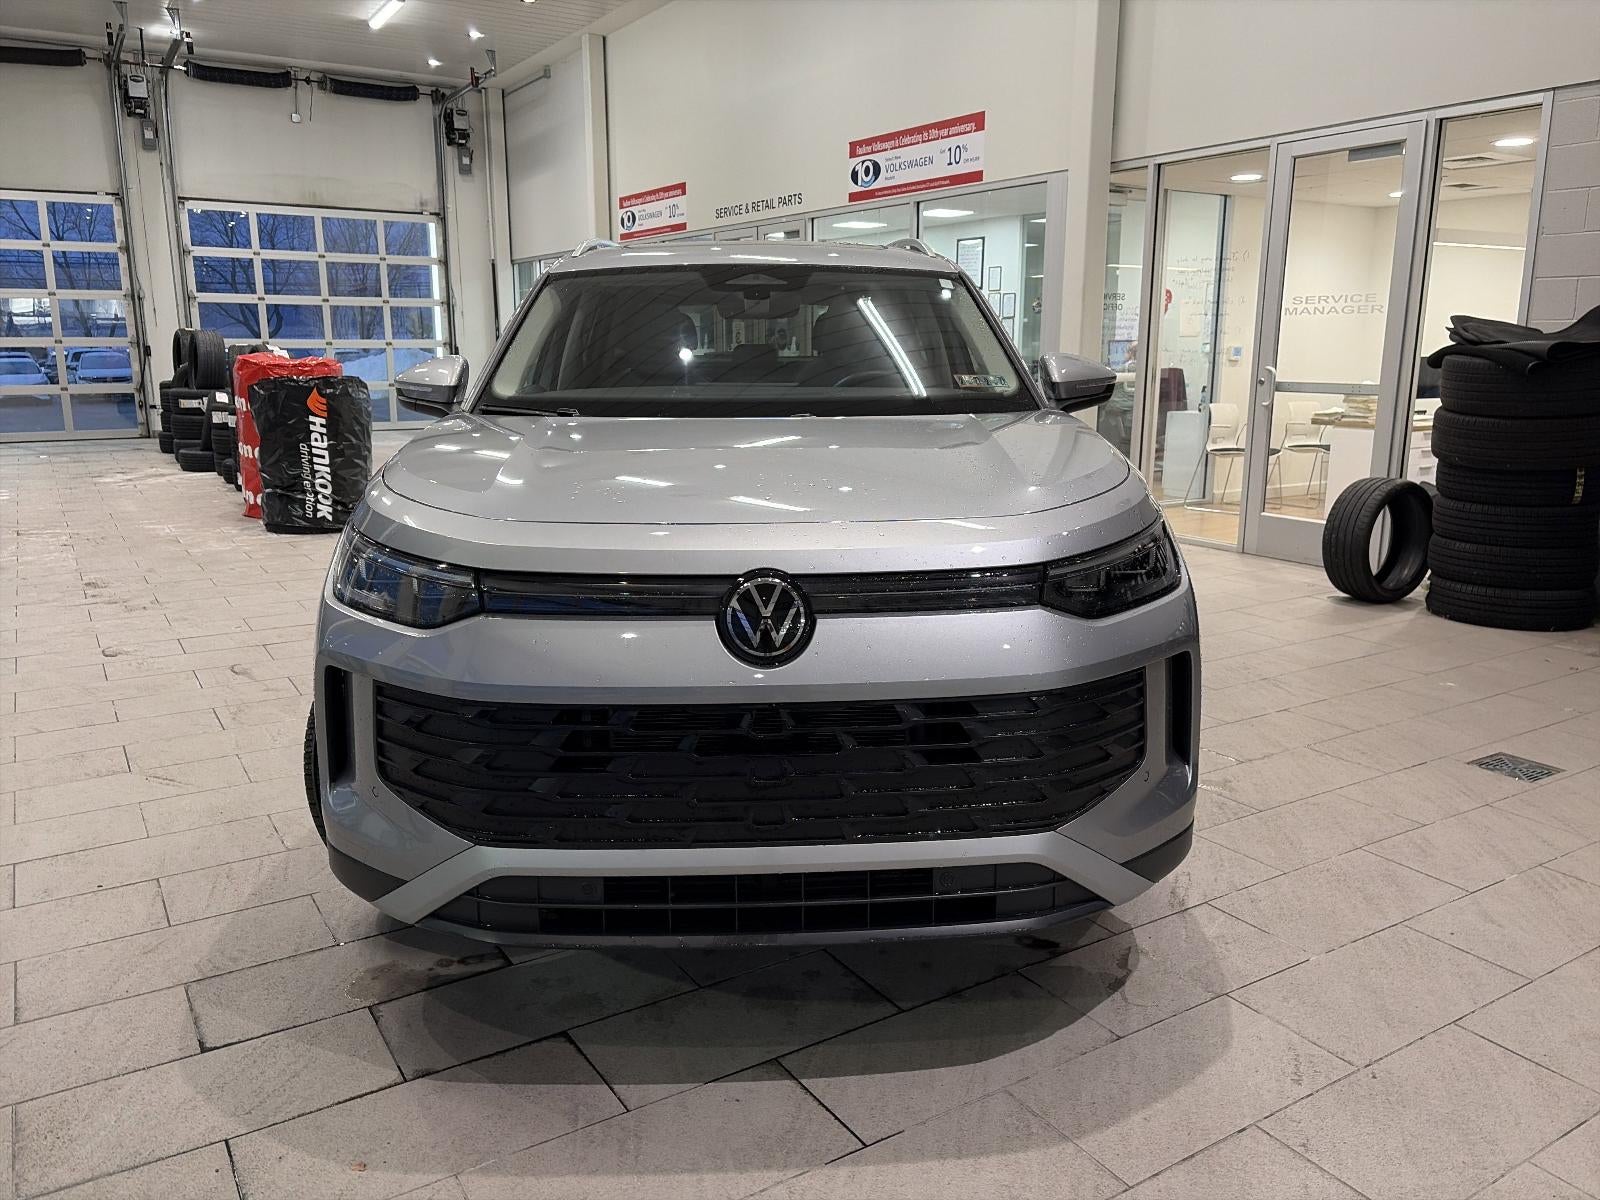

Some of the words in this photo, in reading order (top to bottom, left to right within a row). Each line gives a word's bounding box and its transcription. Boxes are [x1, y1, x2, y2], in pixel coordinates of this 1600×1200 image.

[899, 131, 922, 146] Celebrating
[885, 155, 934, 174] VOLKSWAGEN
[715, 204, 743, 219] SERVICE
[745, 203, 750, 214] &
[752, 198, 776, 213] RETAIL
[778, 192, 803, 208] PARTS
[1292, 293, 1377, 305] SERVICE
[1284, 304, 1385, 316] MANAGER
[300, 443, 312, 479] driving
